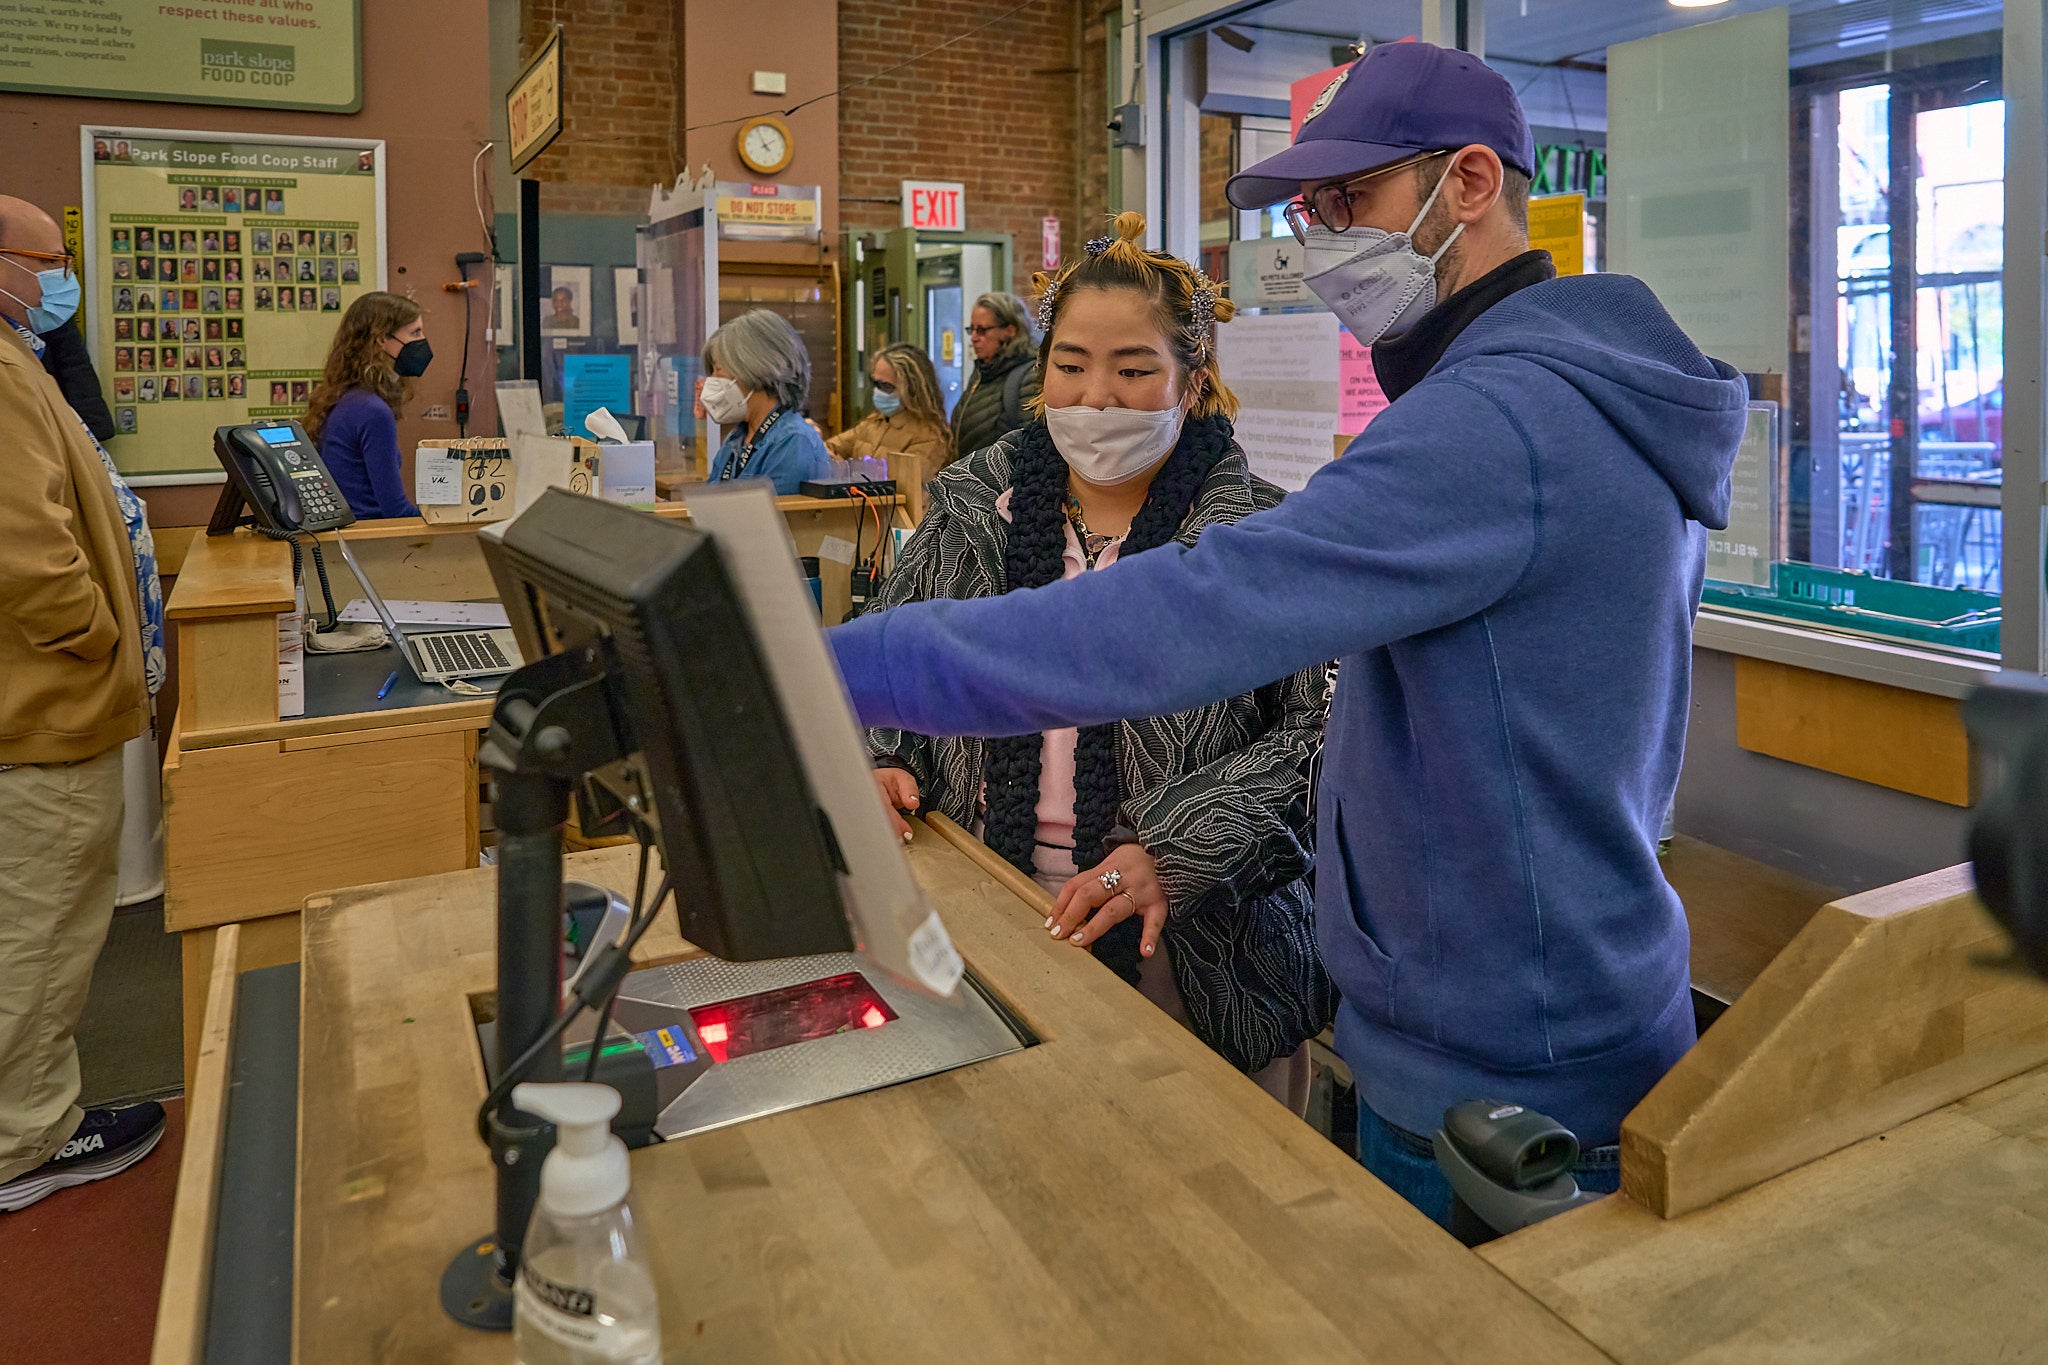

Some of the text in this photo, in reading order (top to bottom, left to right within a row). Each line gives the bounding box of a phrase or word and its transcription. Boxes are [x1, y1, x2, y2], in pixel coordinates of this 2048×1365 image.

[260, 0, 279, 8] all
[282, 0, 313, 12] who
[51, 9, 123, 22] earth-friendly
[159, 5, 321, 29] respect these values.
[44, 20, 61, 29] We
[64, 23, 79, 32] try
[82, 24, 94, 32] to
[96, 24, 118, 34] lead
[120, 26, 133, 37] by
[26, 34, 77, 44] ourselves
[80, 37, 99, 46] and
[102, 39, 136, 49] others
[65, 50, 126, 61] cooperation
[203, 51, 292, 71] park slope
[201, 67, 295, 87] FOOD COOP
[133, 148, 338, 169] Park Slope Food Coop Staff
[751, 185, 776, 195] PLEASE
[730, 201, 798, 215] DO NOT STORE
[911, 189, 960, 228] EXIT
[760, 411, 780, 434] STAFF
